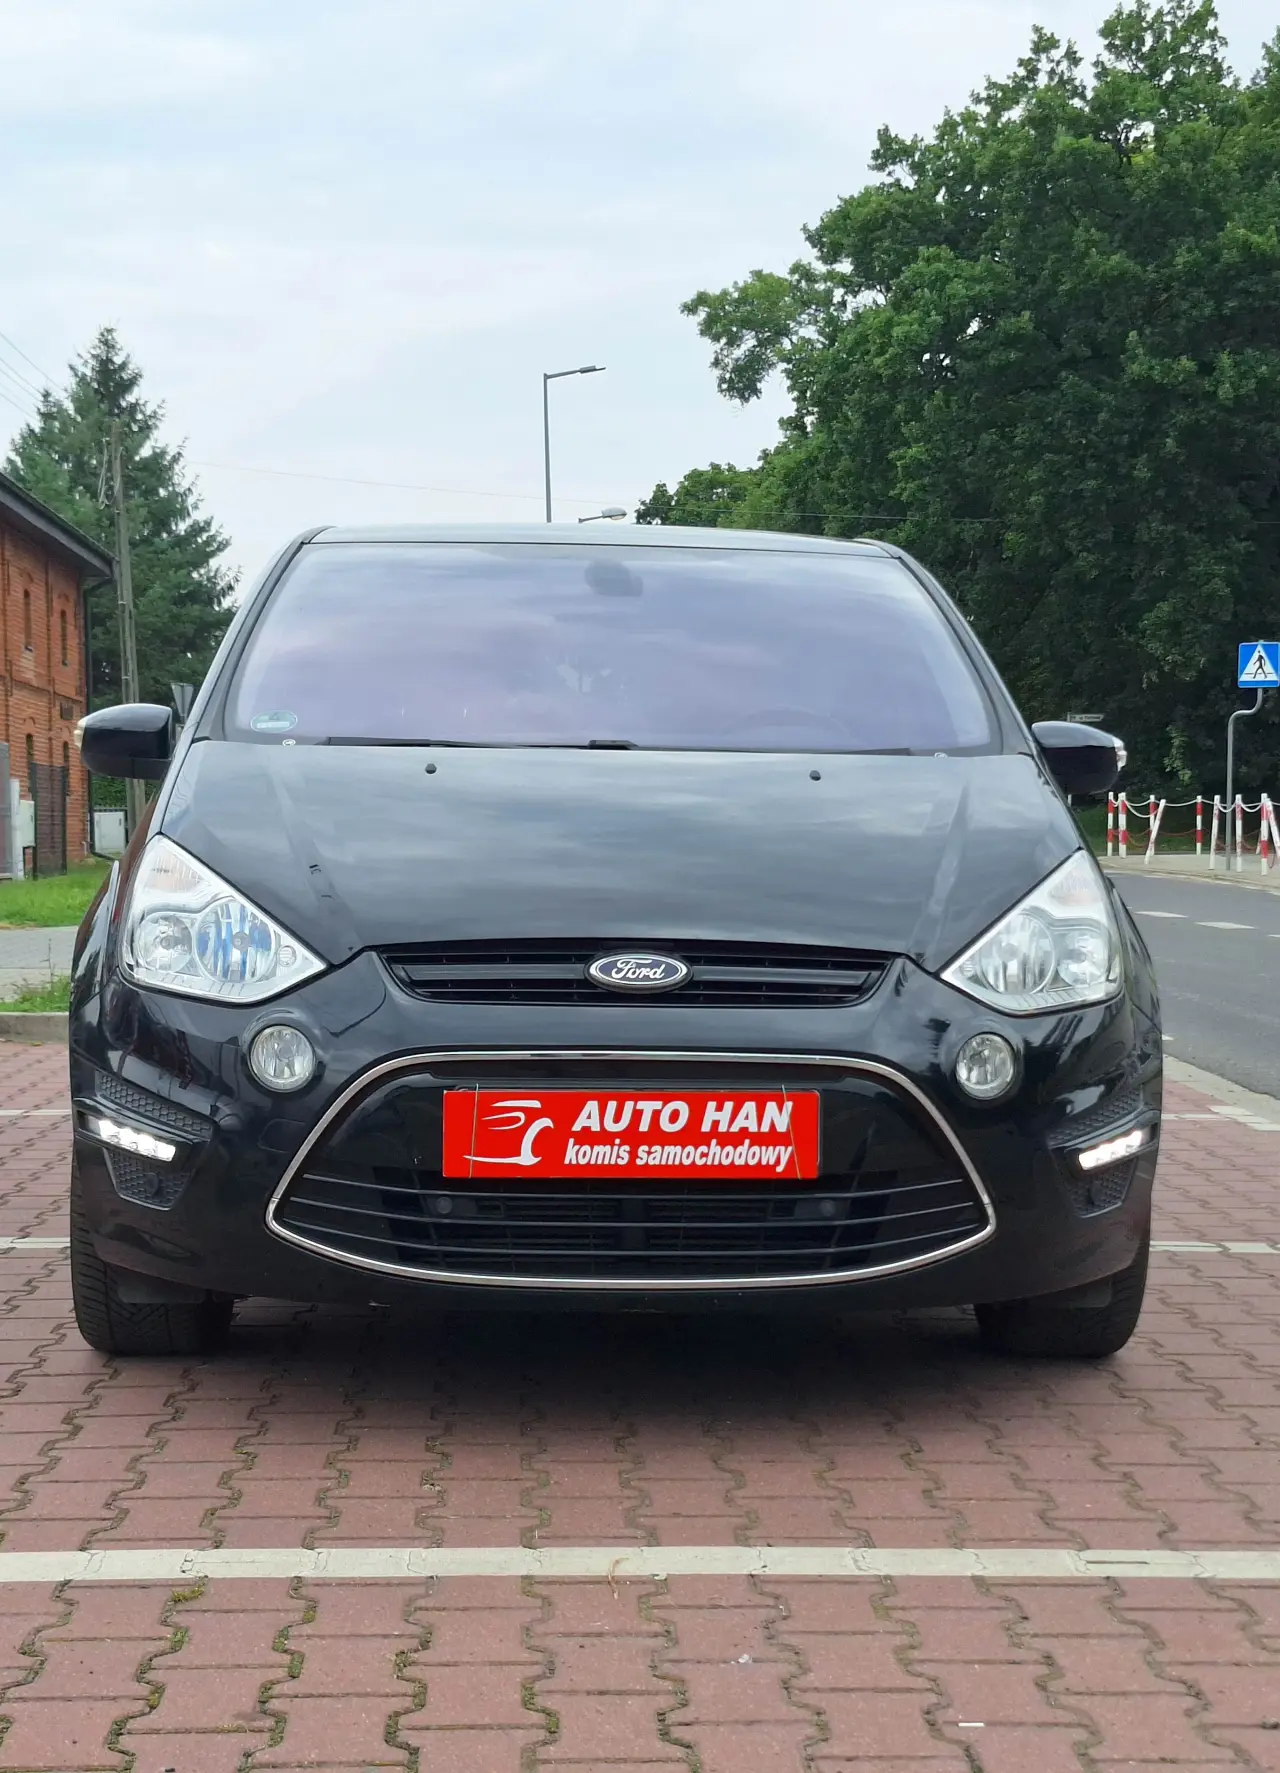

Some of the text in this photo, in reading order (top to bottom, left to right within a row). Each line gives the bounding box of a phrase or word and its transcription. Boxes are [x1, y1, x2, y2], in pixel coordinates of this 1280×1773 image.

[611, 959, 665, 979] Ford
[571, 1100, 793, 1133] AUTO HAN
[564, 1138, 793, 1173] komis samochodowy
